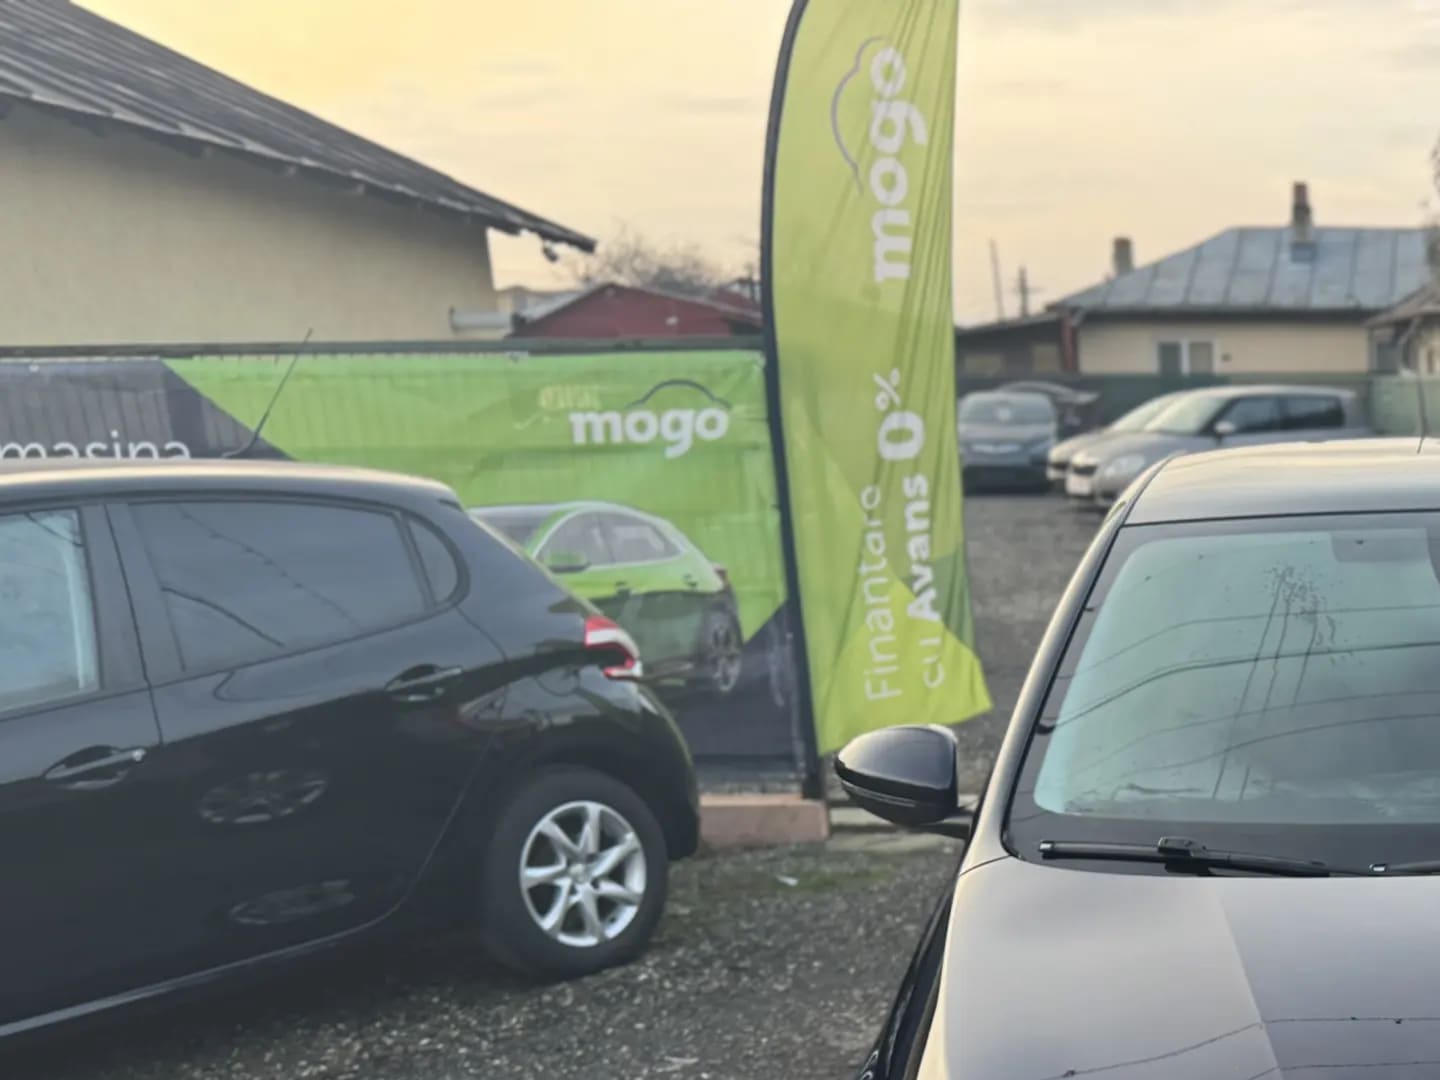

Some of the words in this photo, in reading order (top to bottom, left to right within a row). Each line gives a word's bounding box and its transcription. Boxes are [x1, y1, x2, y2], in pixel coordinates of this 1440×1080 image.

[869, 46, 928, 284] mogo
[569, 406, 730, 460] mogo
[873, 367, 926, 462] 0%
[902, 473, 942, 623] Avans
